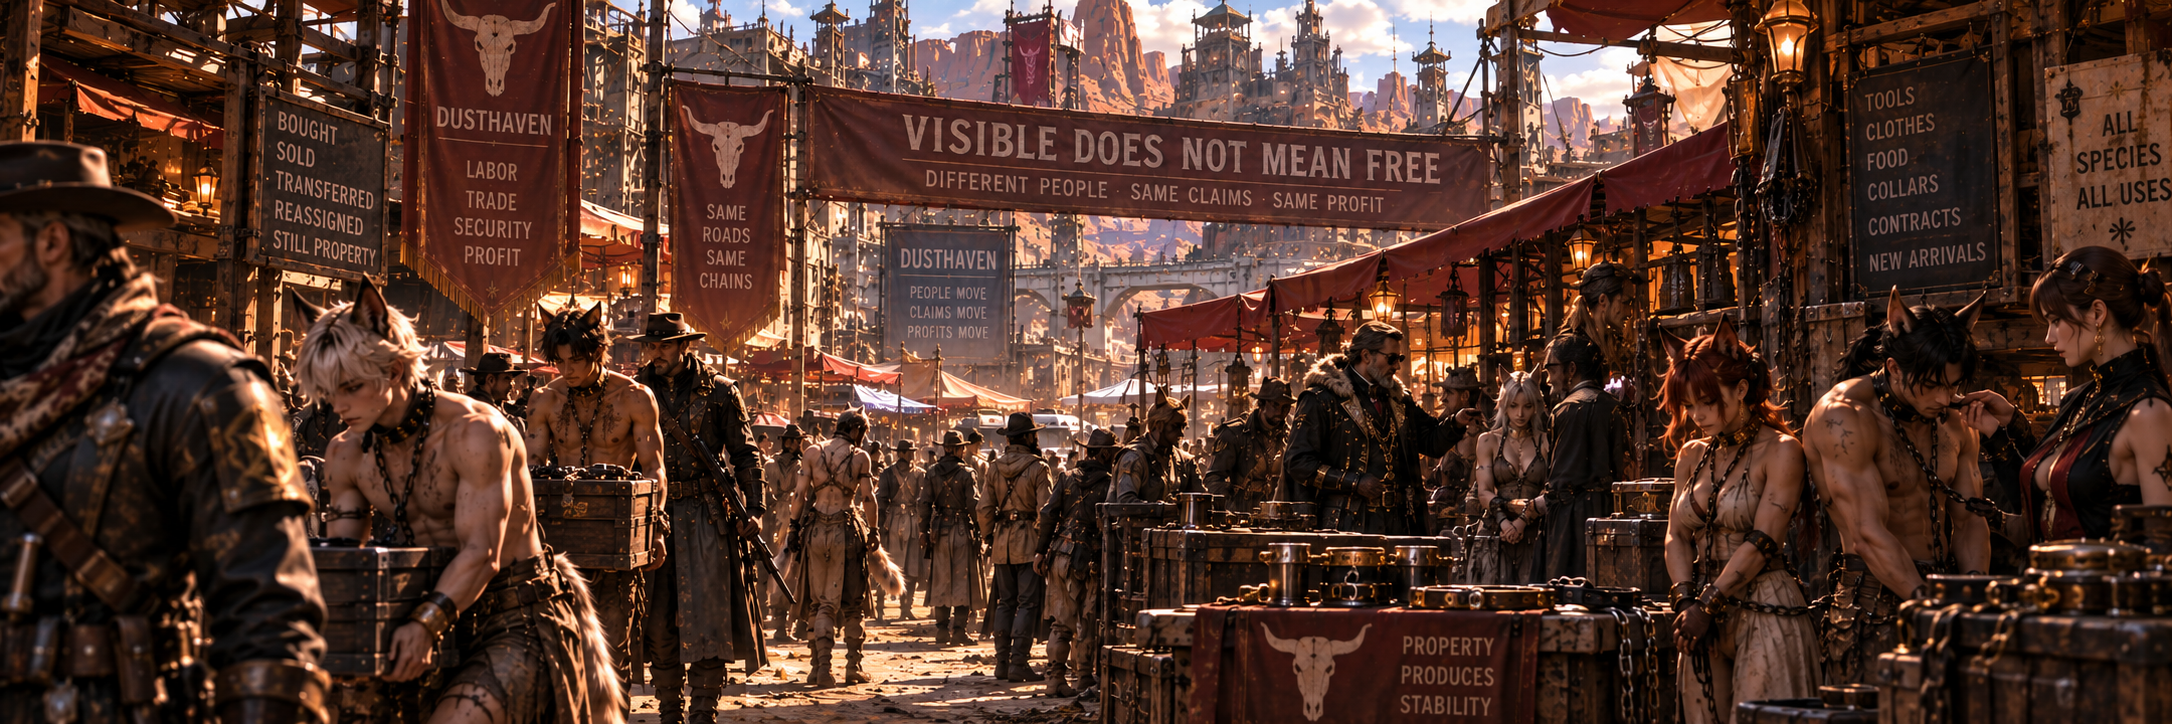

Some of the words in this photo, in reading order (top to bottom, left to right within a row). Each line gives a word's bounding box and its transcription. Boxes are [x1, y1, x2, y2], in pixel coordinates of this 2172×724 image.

[1865, 86, 1915, 112] TOOLS
[277, 110, 338, 145] BOUGHT
[436, 105, 552, 136] DUSTHAVEN
[1866, 113, 1936, 141] CLOTHES
[2102, 110, 2138, 137] ALL
[276, 141, 316, 168] SOLD
[902, 114, 1057, 162] VISIBLE
[1074, 128, 1164, 168] DOES
[1181, 137, 1247, 174] NOT
[1261, 142, 1350, 180] MEAN
[1366, 149, 1441, 185] FREE
[1867, 148, 1909, 172] FOOD
[2076, 142, 2162, 174] SPECIES
[466, 160, 518, 182] LABOR
[275, 169, 374, 210] TRANSFERRED
[925, 169, 1029, 194] DIFFERENT
[1040, 177, 1108, 199] PEOPLE
[1130, 183, 1179, 202] SAME
[1188, 187, 1252, 207] CLAIMS
[1273, 191, 1318, 210] SAME
[1327, 194, 1384, 213] PROFIT
[1867, 174, 1939, 201] COLLARS
[2076, 184, 2113, 210] ALL
[2120, 177, 2172, 206] USES
[465, 190, 517, 212] TRADE
[706, 203, 746, 221] SAME
[274, 200, 364, 236] REASSIGNED
[454, 216, 532, 240] SECURITY
[1868, 207, 1962, 236] CONTRACTS
[702, 226, 751, 244] ROADS
[273, 229, 309, 255] STILL
[314, 237, 377, 267] PROPERTY
[464, 245, 521, 267] PROFIT
[706, 250, 746, 267] SAME
[900, 248, 997, 270] DUSTHAVEN
[1869, 251, 1902, 273] NEW
[1908, 241, 1987, 269] ARRIVALS
[700, 272, 753, 290] CHAINS
[910, 285, 950, 300] PEOPLE
[956, 286, 987, 301] MOVE
[909, 305, 952, 320] CLAIMS
[956, 306, 987, 320] MOVE
[907, 325, 953, 339] PROFITS
[957, 325, 989, 340] MOVE
[1402, 635, 1495, 657] PROPERTY
[1400, 665, 1495, 687] PRODUCES
[1400, 695, 1492, 717] STABILITY
